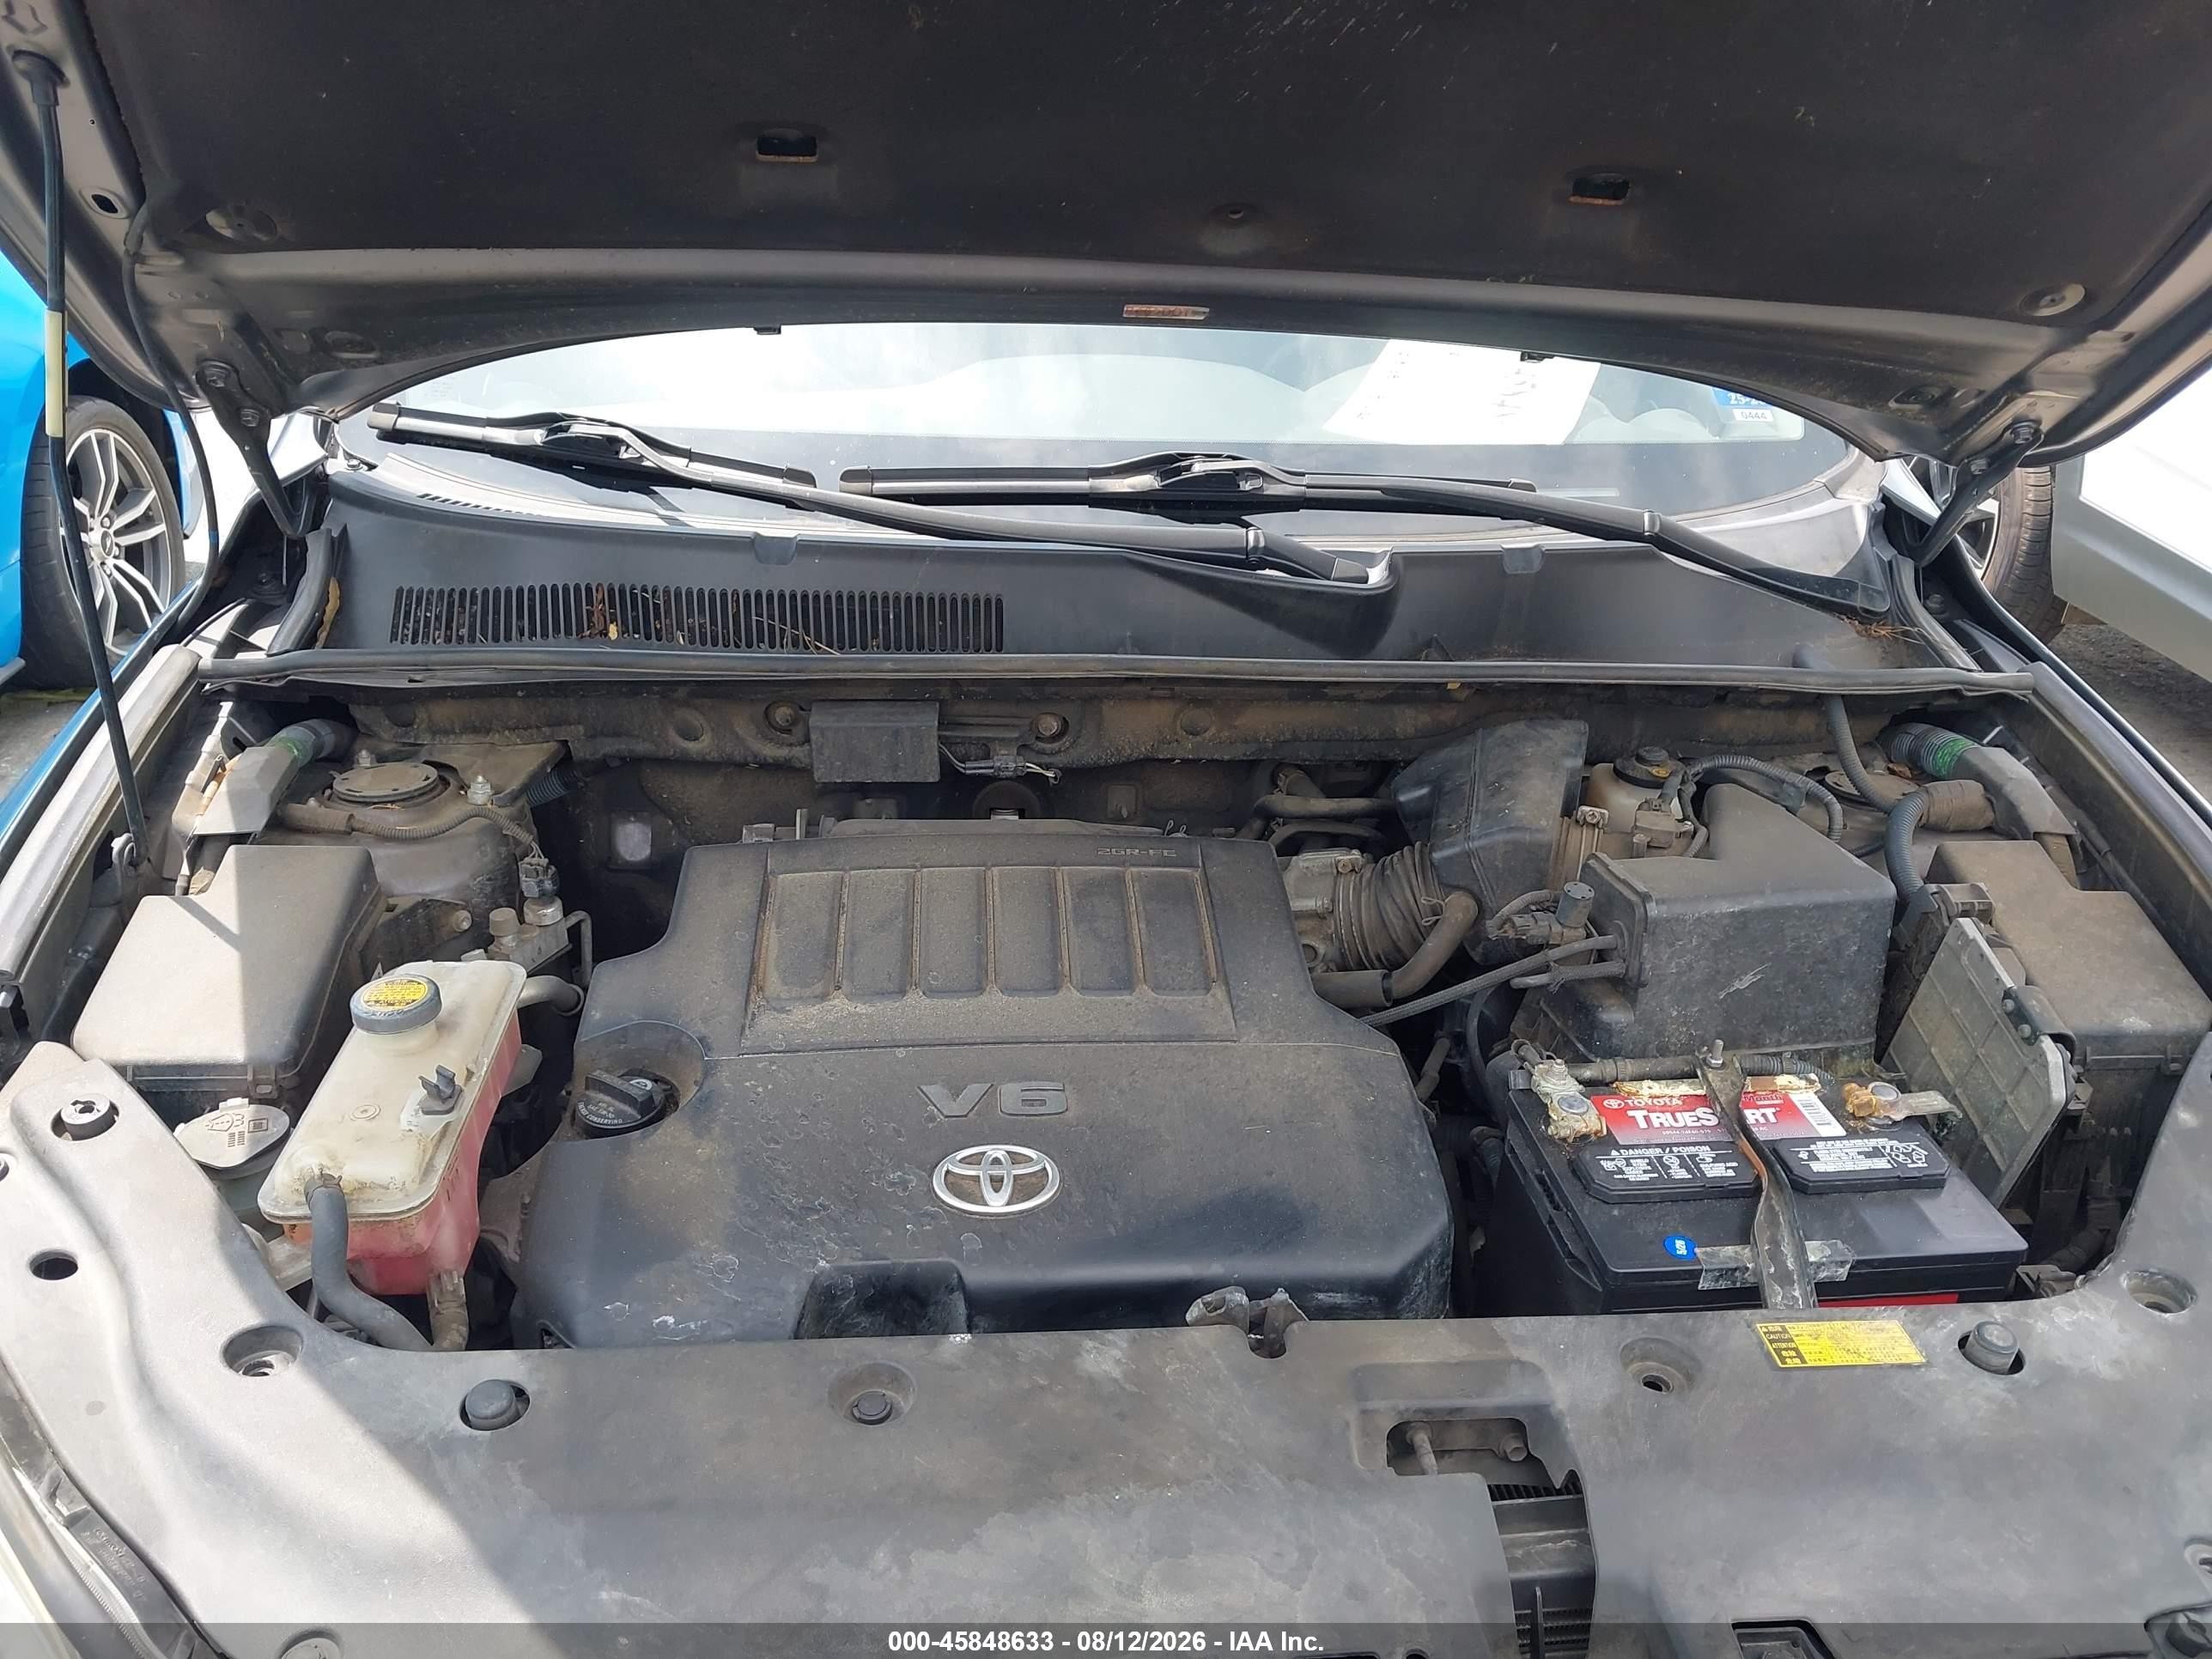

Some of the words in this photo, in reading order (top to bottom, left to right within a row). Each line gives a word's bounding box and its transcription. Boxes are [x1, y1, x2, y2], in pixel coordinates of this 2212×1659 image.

[1741, 411, 1767, 420] 0444
[1097, 848, 1177, 858] 2GR-FE
[916, 1081, 1069, 1119] V6
[1625, 1097, 1682, 1107] TOYOTA
[1620, 1147, 1664, 1156] DANGER
